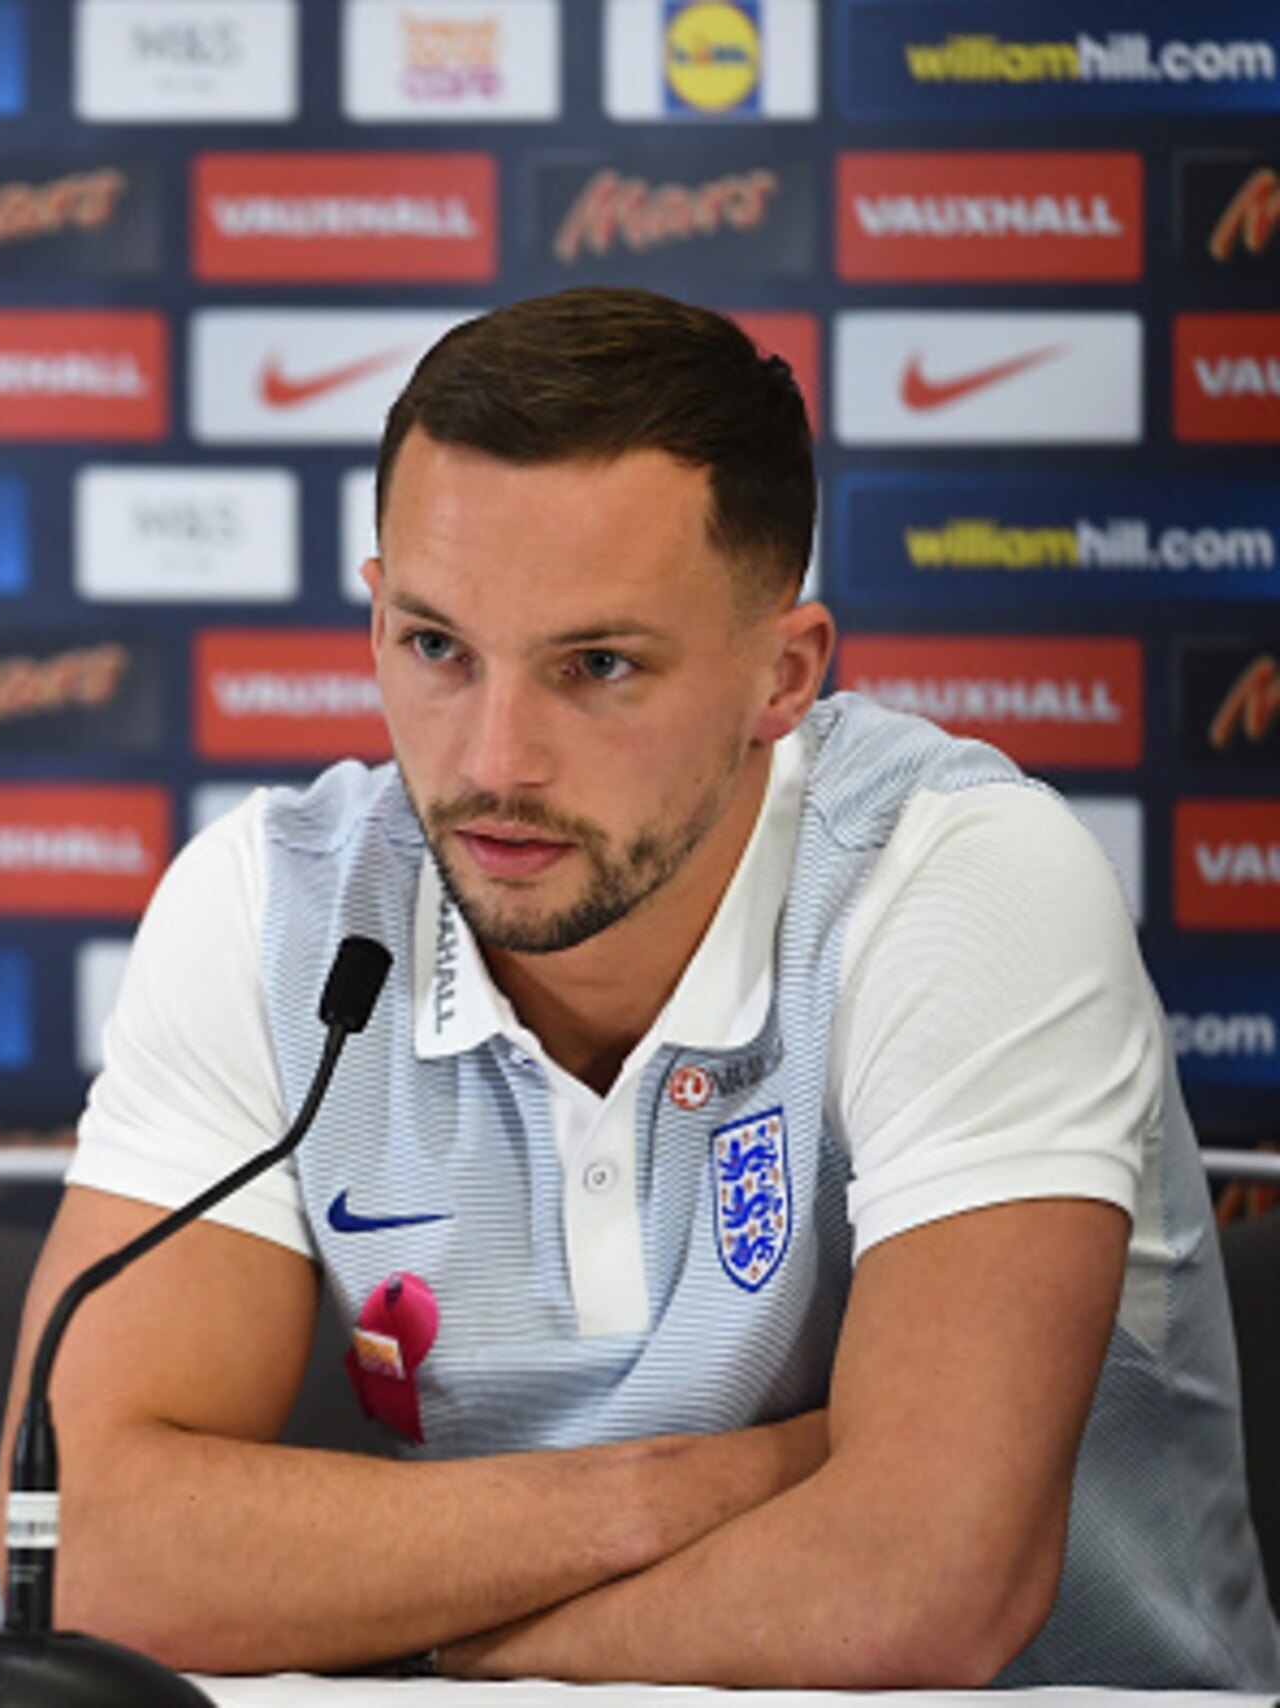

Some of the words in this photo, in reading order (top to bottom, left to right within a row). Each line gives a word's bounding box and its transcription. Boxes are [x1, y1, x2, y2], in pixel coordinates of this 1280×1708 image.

[905, 33, 1277, 82] williamhill.com
[210, 194, 477, 238] VAUXHALL
[554, 168, 778, 266] Mars
[854, 195, 1124, 238] VAUXHALL
[905, 518, 1277, 569] williamhill.com
